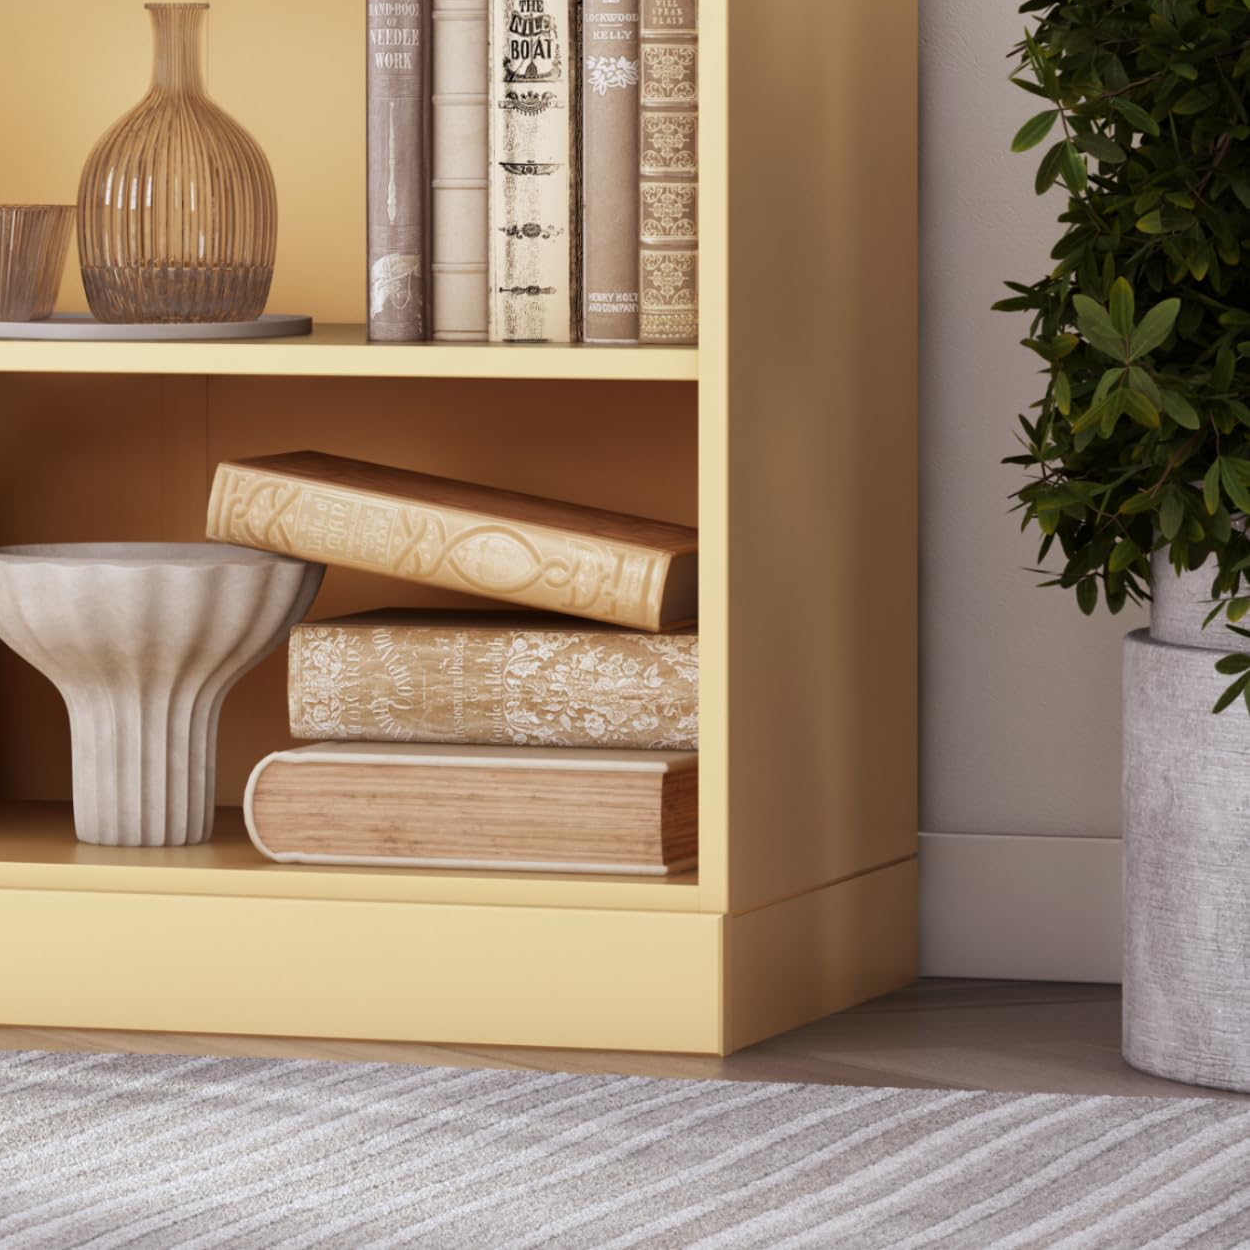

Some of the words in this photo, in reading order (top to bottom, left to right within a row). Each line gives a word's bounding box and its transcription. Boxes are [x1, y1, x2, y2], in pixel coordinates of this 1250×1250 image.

[518, 0, 544, 13] THE
[369, 29, 420, 46] NEEDLE
[593, 30, 632, 40] KELLY
[511, 38, 553, 60] BOAT
[374, 52, 414, 70] WORK
[452, 690, 470, 741] hysician
